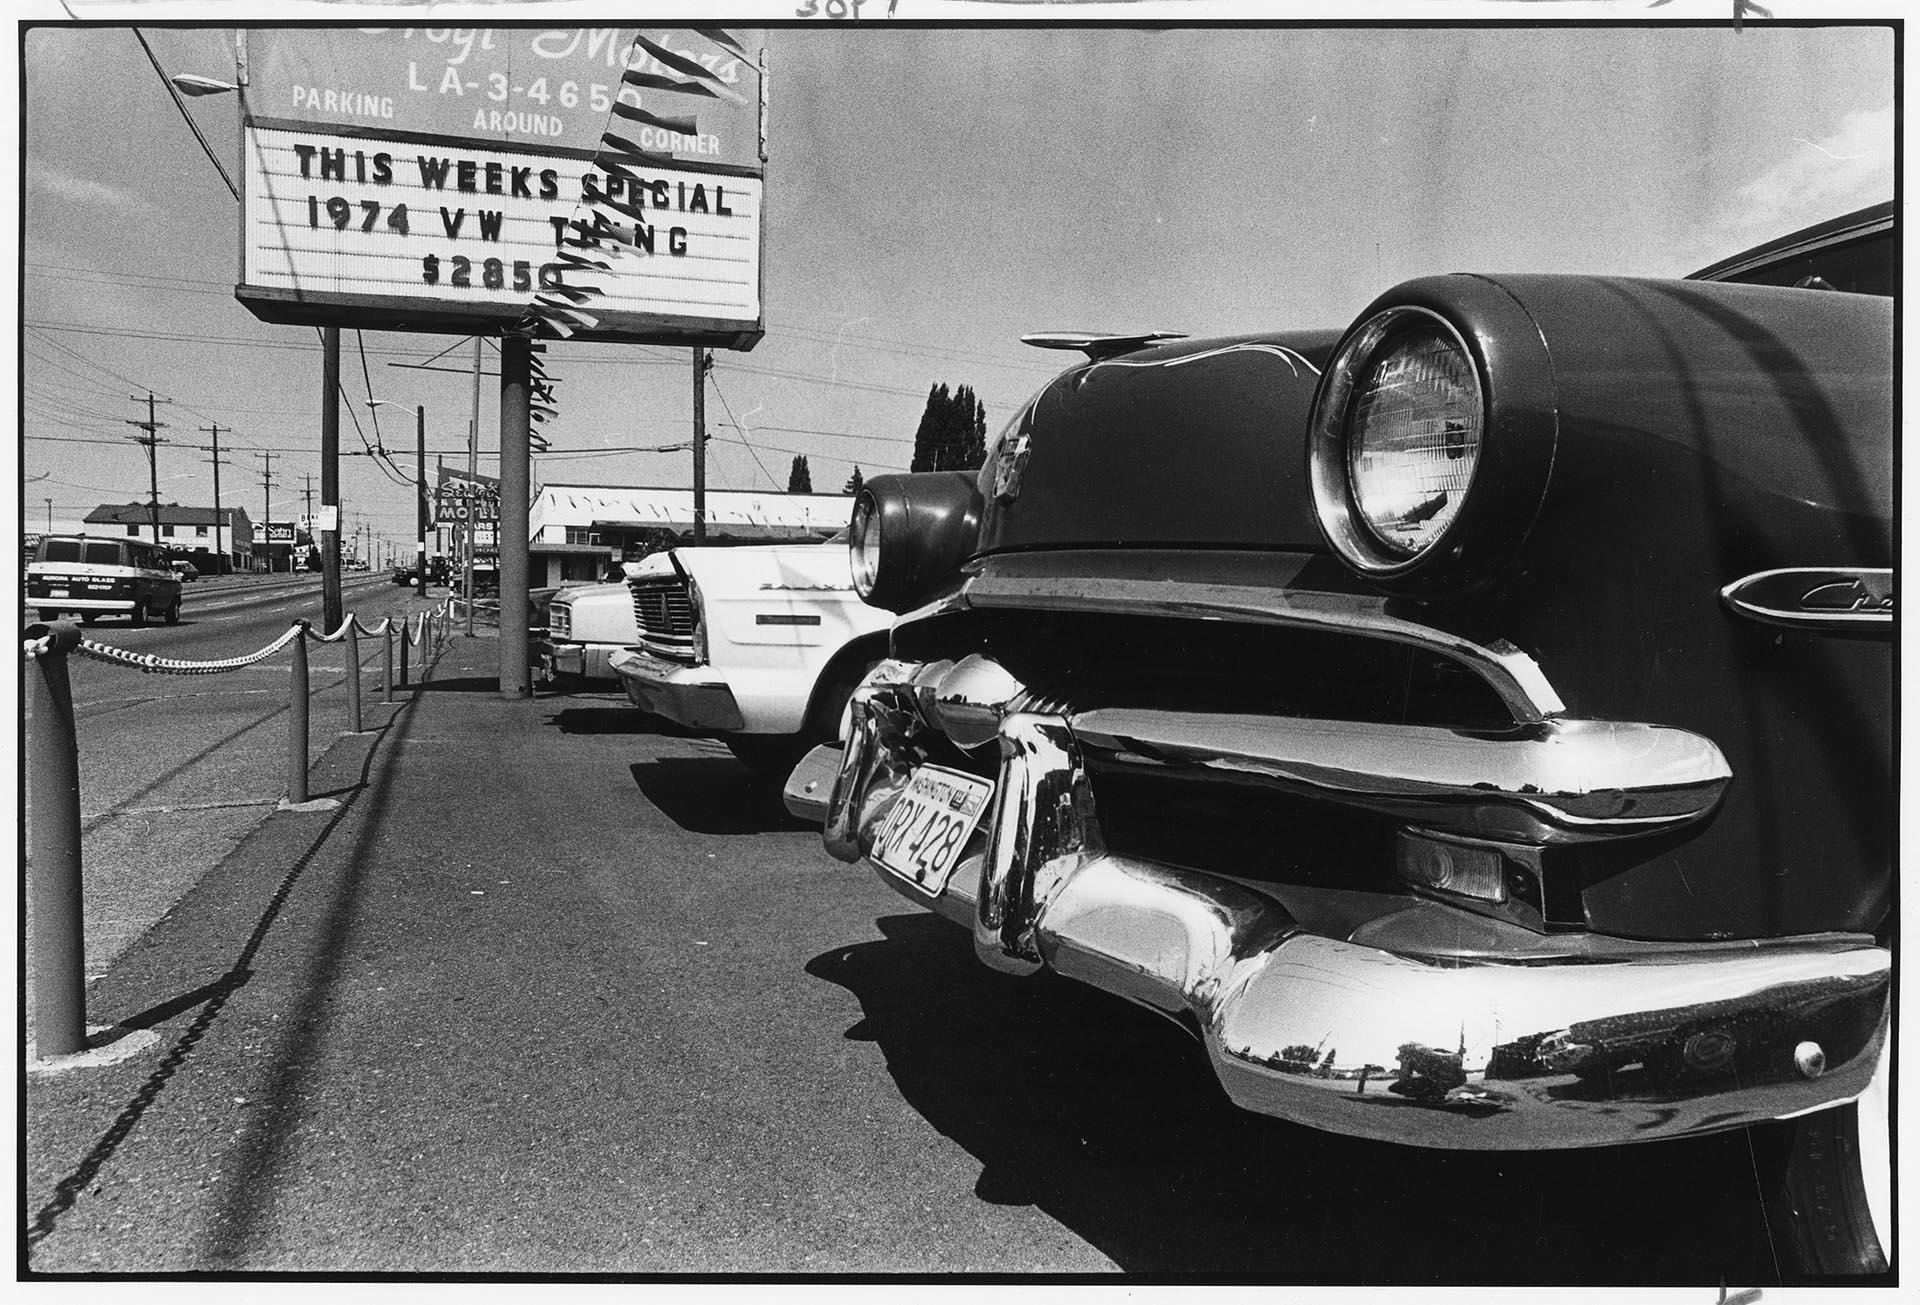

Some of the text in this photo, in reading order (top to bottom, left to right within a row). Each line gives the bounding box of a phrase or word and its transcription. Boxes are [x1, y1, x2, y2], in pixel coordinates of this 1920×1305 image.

[292, 86, 721, 156] PARKING AROUND CORNER
[294, 144, 732, 216] THIS WEEKS SPECIAL
[307, 196, 410, 236] 1974
[422, 254, 563, 291] $2850
[908, 811, 965, 873] 428
